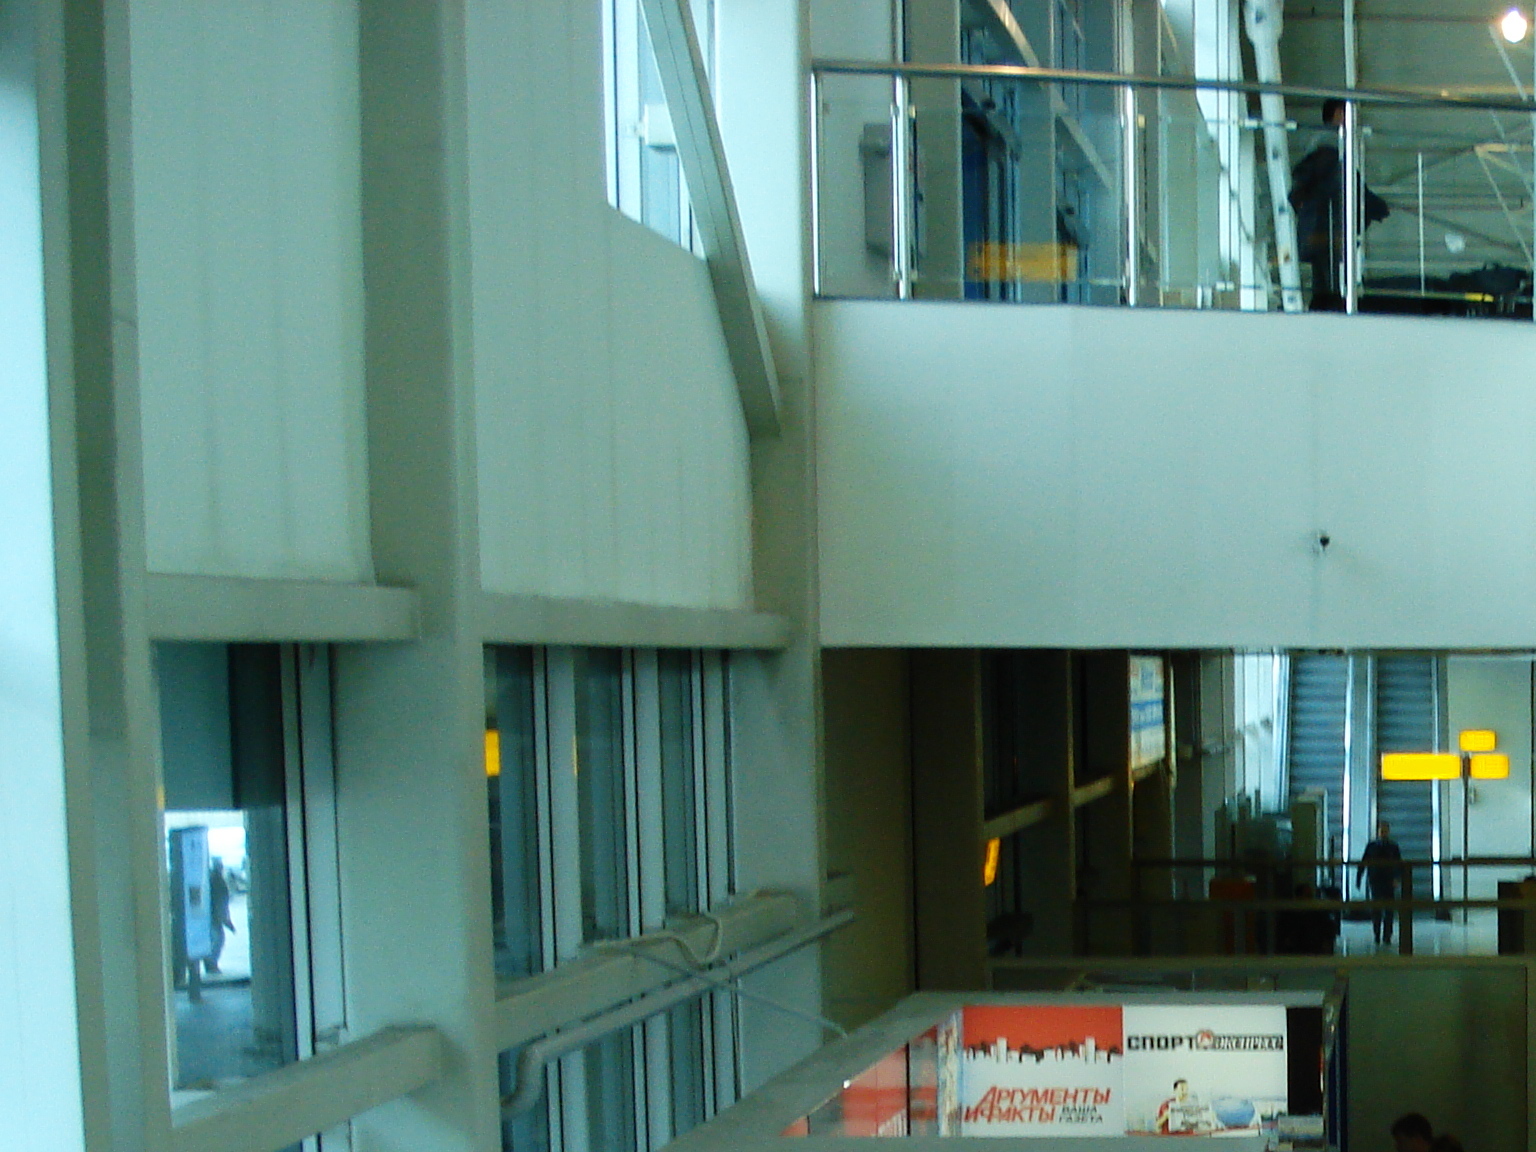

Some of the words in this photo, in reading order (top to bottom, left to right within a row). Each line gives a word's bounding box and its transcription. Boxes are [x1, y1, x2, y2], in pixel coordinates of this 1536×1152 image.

[1127, 1034, 1194, 1050] СПОРТ
[975, 1086, 1111, 1113] АРГУМЕНТЫ
[1059, 1114, 1103, 1123] ГАЗЕТА
